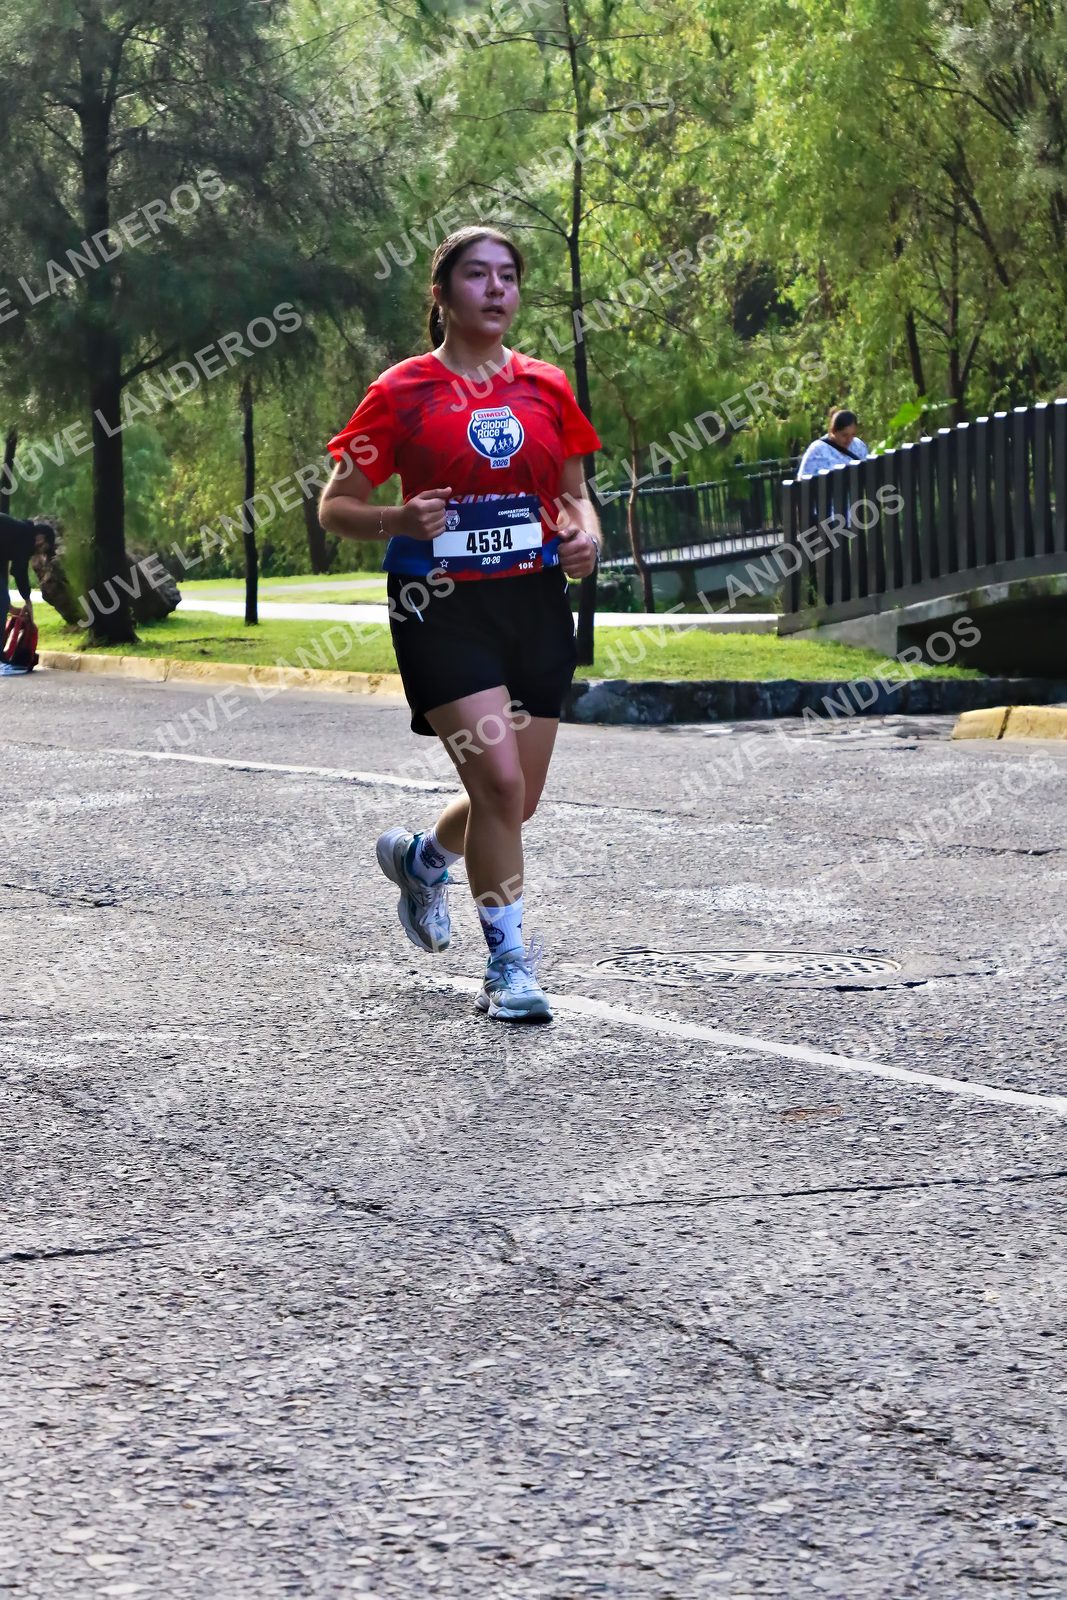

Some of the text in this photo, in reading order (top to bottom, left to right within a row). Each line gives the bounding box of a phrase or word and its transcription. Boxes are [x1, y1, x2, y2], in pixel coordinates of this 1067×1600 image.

[481, 419, 509, 430] Global
[477, 429, 500, 439] Race
[492, 459, 509, 467] 2026
[466, 528, 513, 553] 4534
[518, 562, 534, 570] 10K
